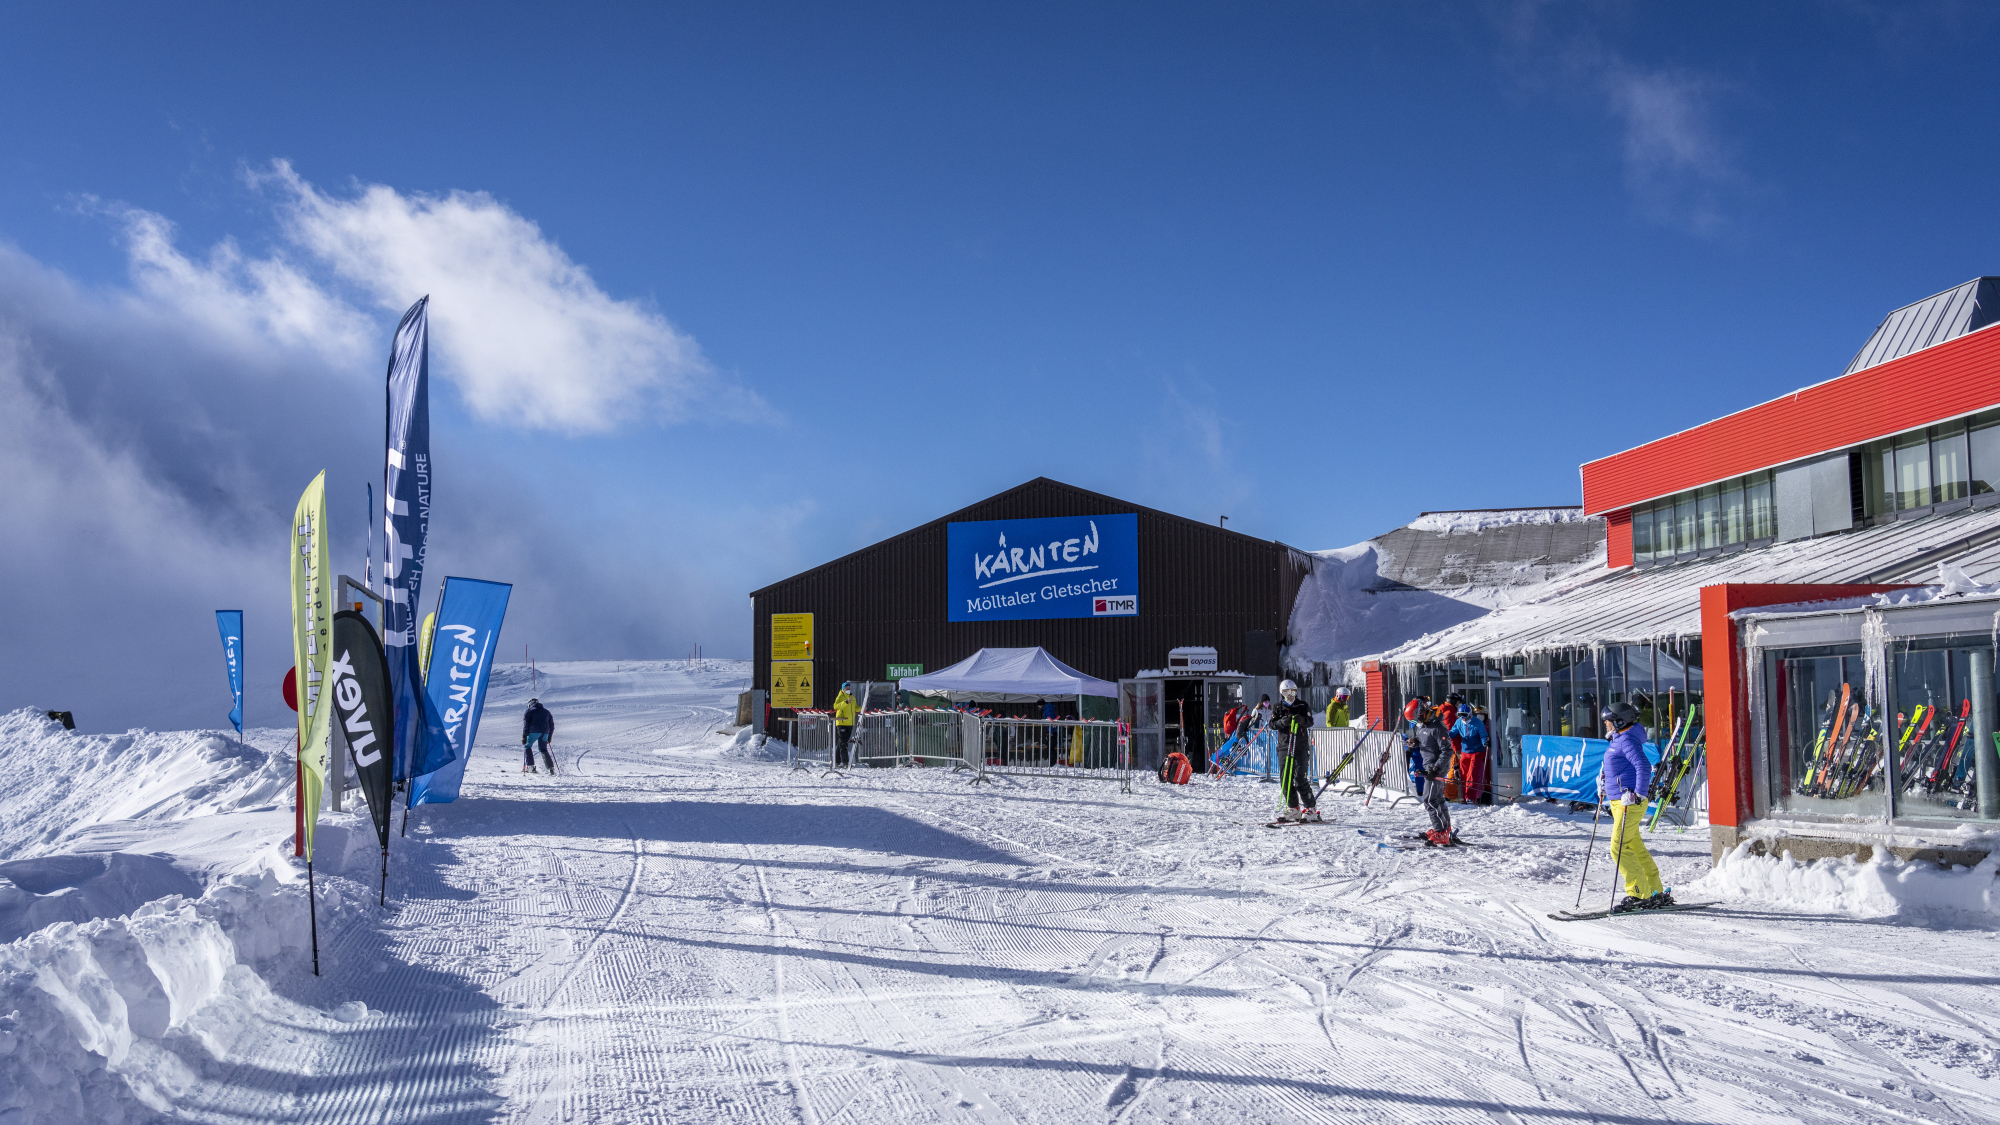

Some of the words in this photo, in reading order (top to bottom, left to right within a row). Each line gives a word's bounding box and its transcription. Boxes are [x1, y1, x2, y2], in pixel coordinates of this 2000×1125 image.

[415, 453, 430, 519] NATURE
[974, 520, 1100, 580] KÄRNTEN
[966, 590, 1037, 613] Mölltaler
[1040, 577, 1119, 601] Gletscher
[1107, 599, 1135, 611] TMR
[889, 665, 920, 678] Talfahrt
[332, 649, 382, 769] uvex
